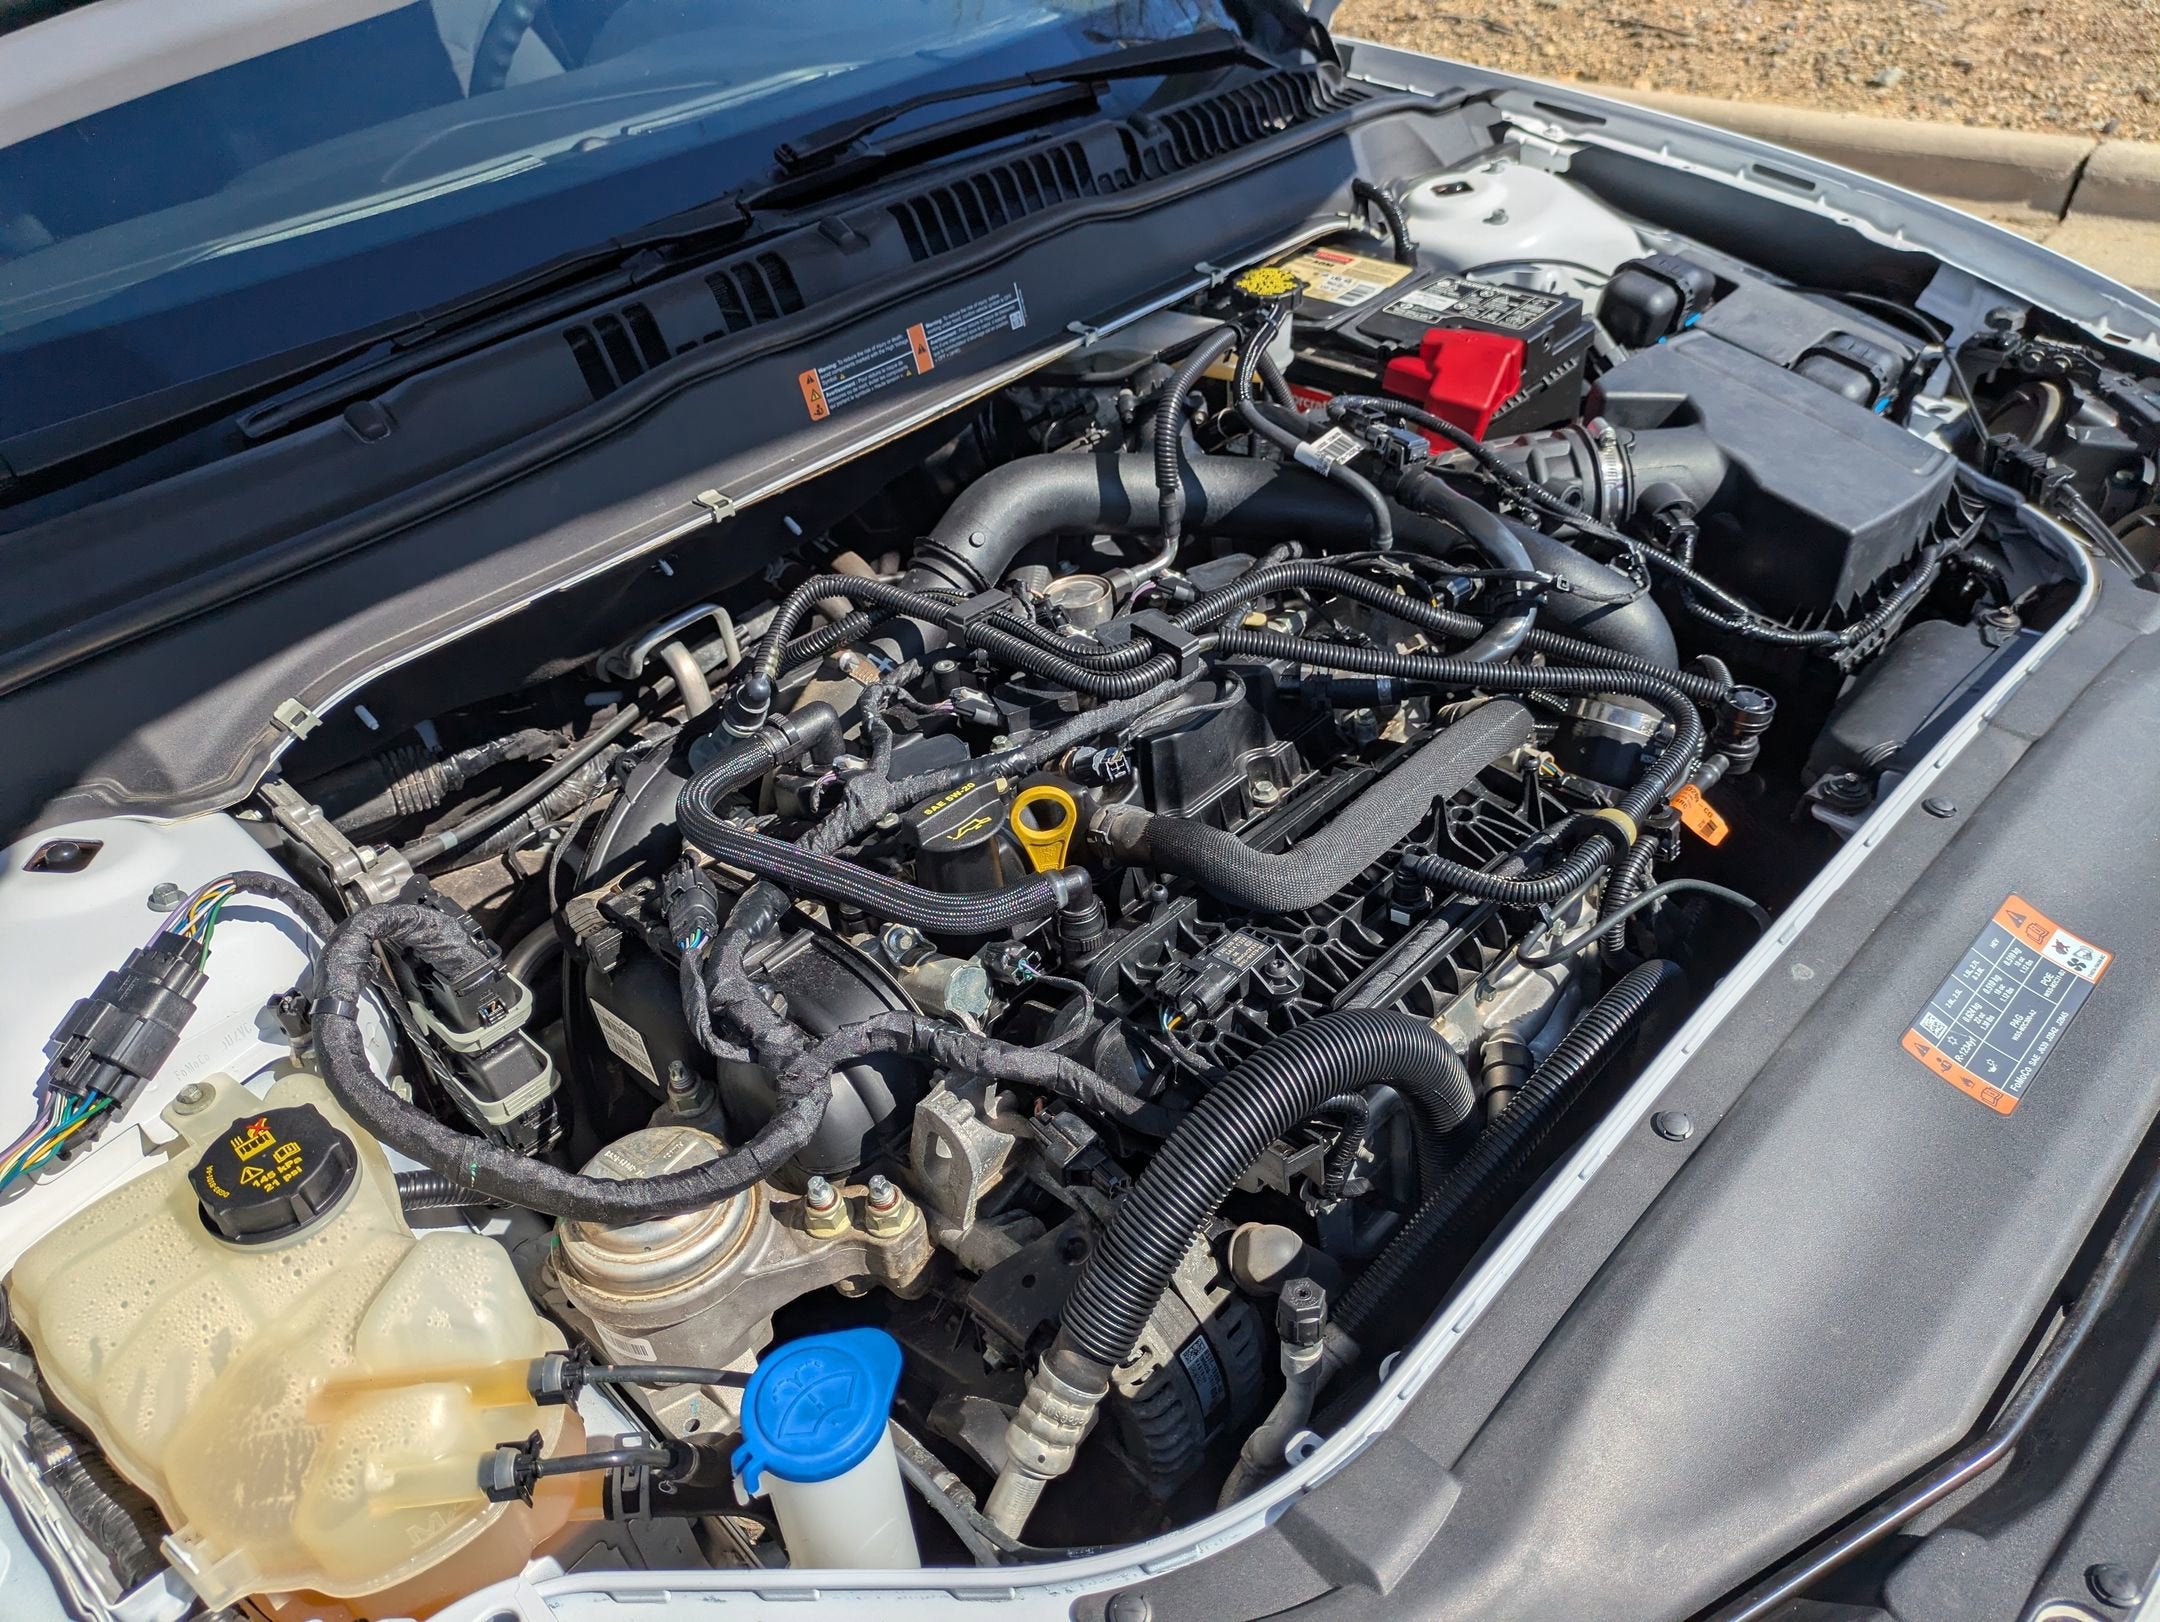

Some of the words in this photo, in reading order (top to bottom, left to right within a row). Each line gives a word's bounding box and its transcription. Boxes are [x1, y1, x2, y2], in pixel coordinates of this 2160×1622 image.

[924, 801, 946, 815] SAE
[945, 782, 975, 801] 5W-20
[2011, 947, 2022, 955] kg
[1991, 974, 2002, 982] kg
[2040, 972, 2054, 986] POE
[1971, 1002, 1983, 1010] kg
[2009, 1014, 2024, 1028] PAG
[1954, 1035, 1976, 1062] R-1234yf
[2010, 1067, 2032, 1092] FoMoCo
[2028, 1054, 2041, 1066] SAE
[252, 1170, 276, 1187] 145
[277, 1157, 302, 1173] kPa
[264, 1179, 280, 1192] 21
[283, 1166, 302, 1182] psi
